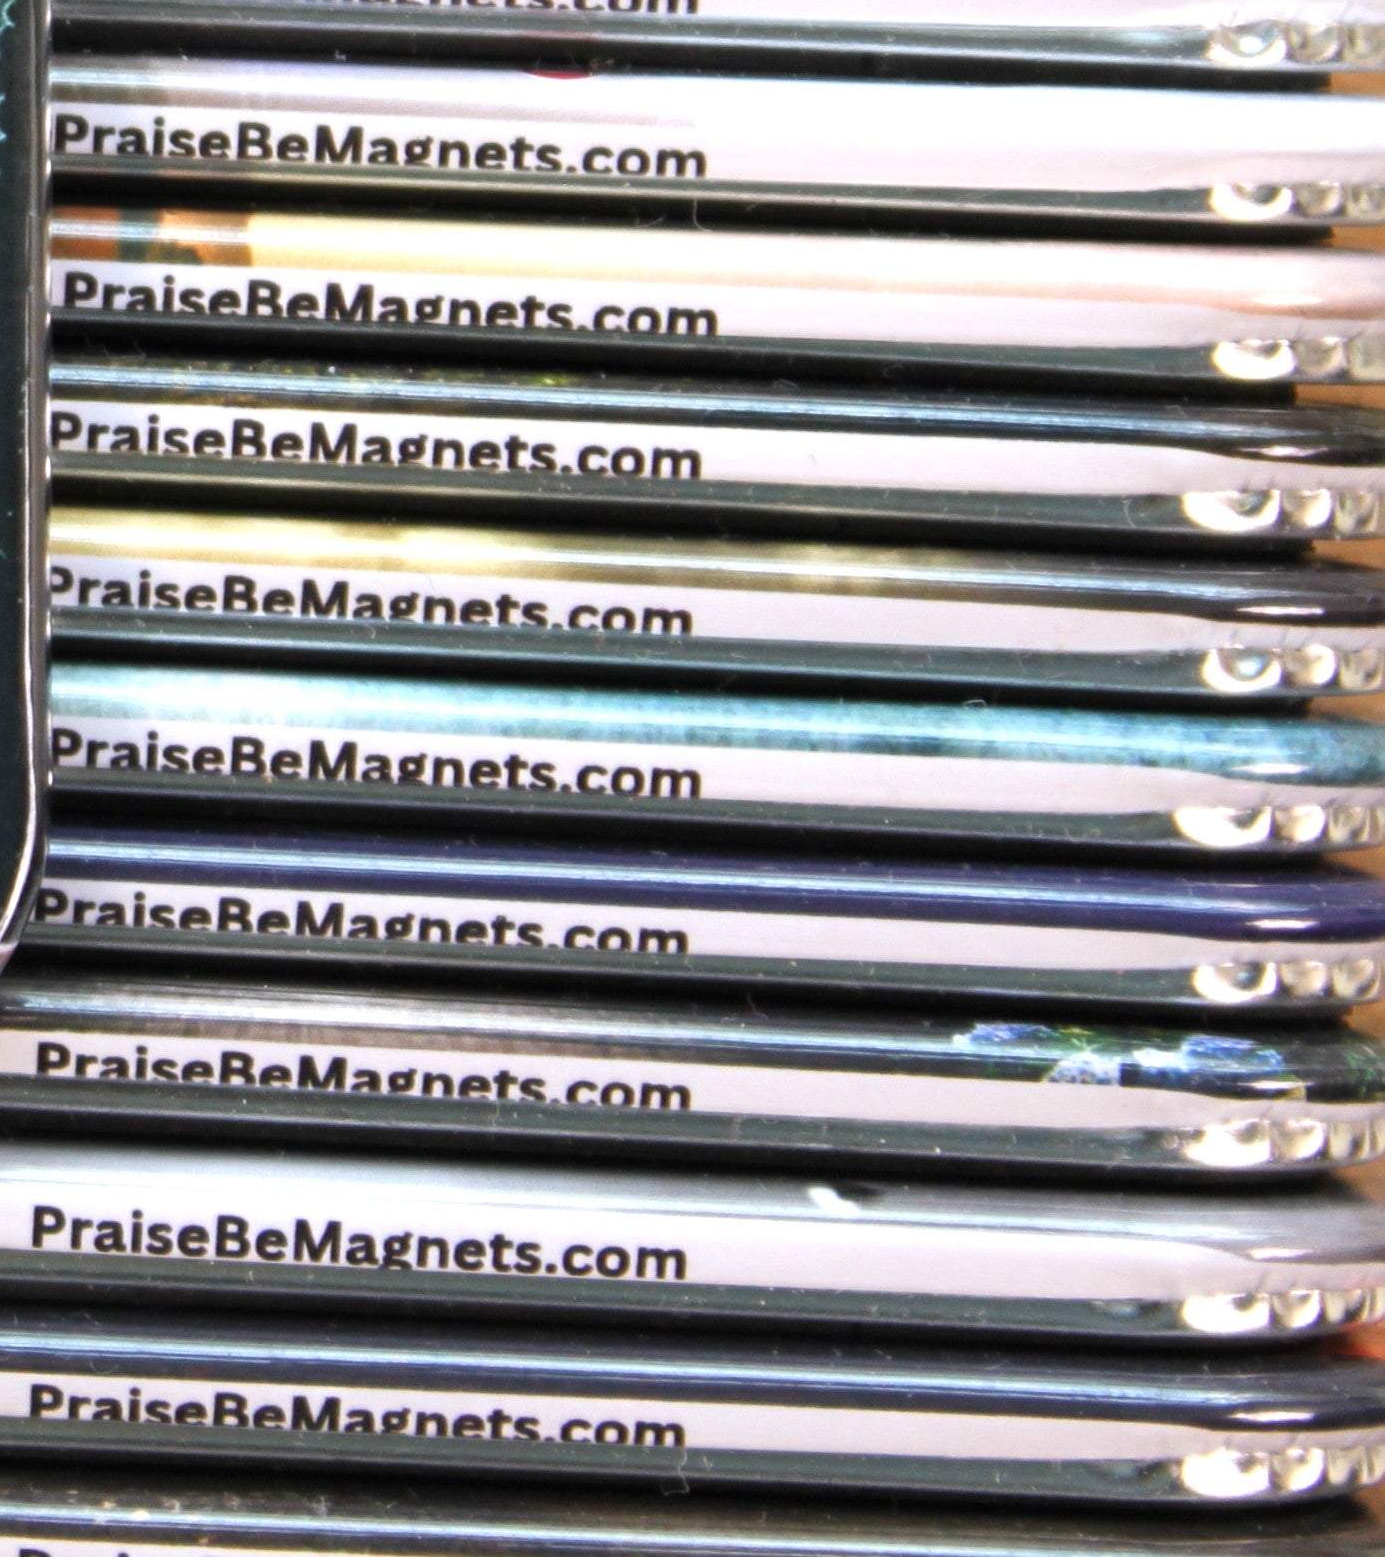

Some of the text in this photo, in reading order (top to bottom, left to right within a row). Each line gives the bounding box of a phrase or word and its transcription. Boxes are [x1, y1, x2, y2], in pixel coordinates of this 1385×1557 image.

[54, 114, 707, 178] PraiseBeMagnets.com
[63, 272, 717, 336] PraiseBeMagnets.com
[51, 412, 702, 479] PraiseBeMagnets.com
[51, 565, 692, 636] PraiseBeMagnets.com
[52, 727, 702, 797] PraiseBeMagnets.com
[35, 887, 688, 954] PraiseBeMagnets.com
[36, 1042, 692, 1110] PraiseBeMagnets.com
[32, 1205, 687, 1280] PraiseBeMagnets.com
[28, 1383, 685, 1447] PraiseBeMagnets.com
